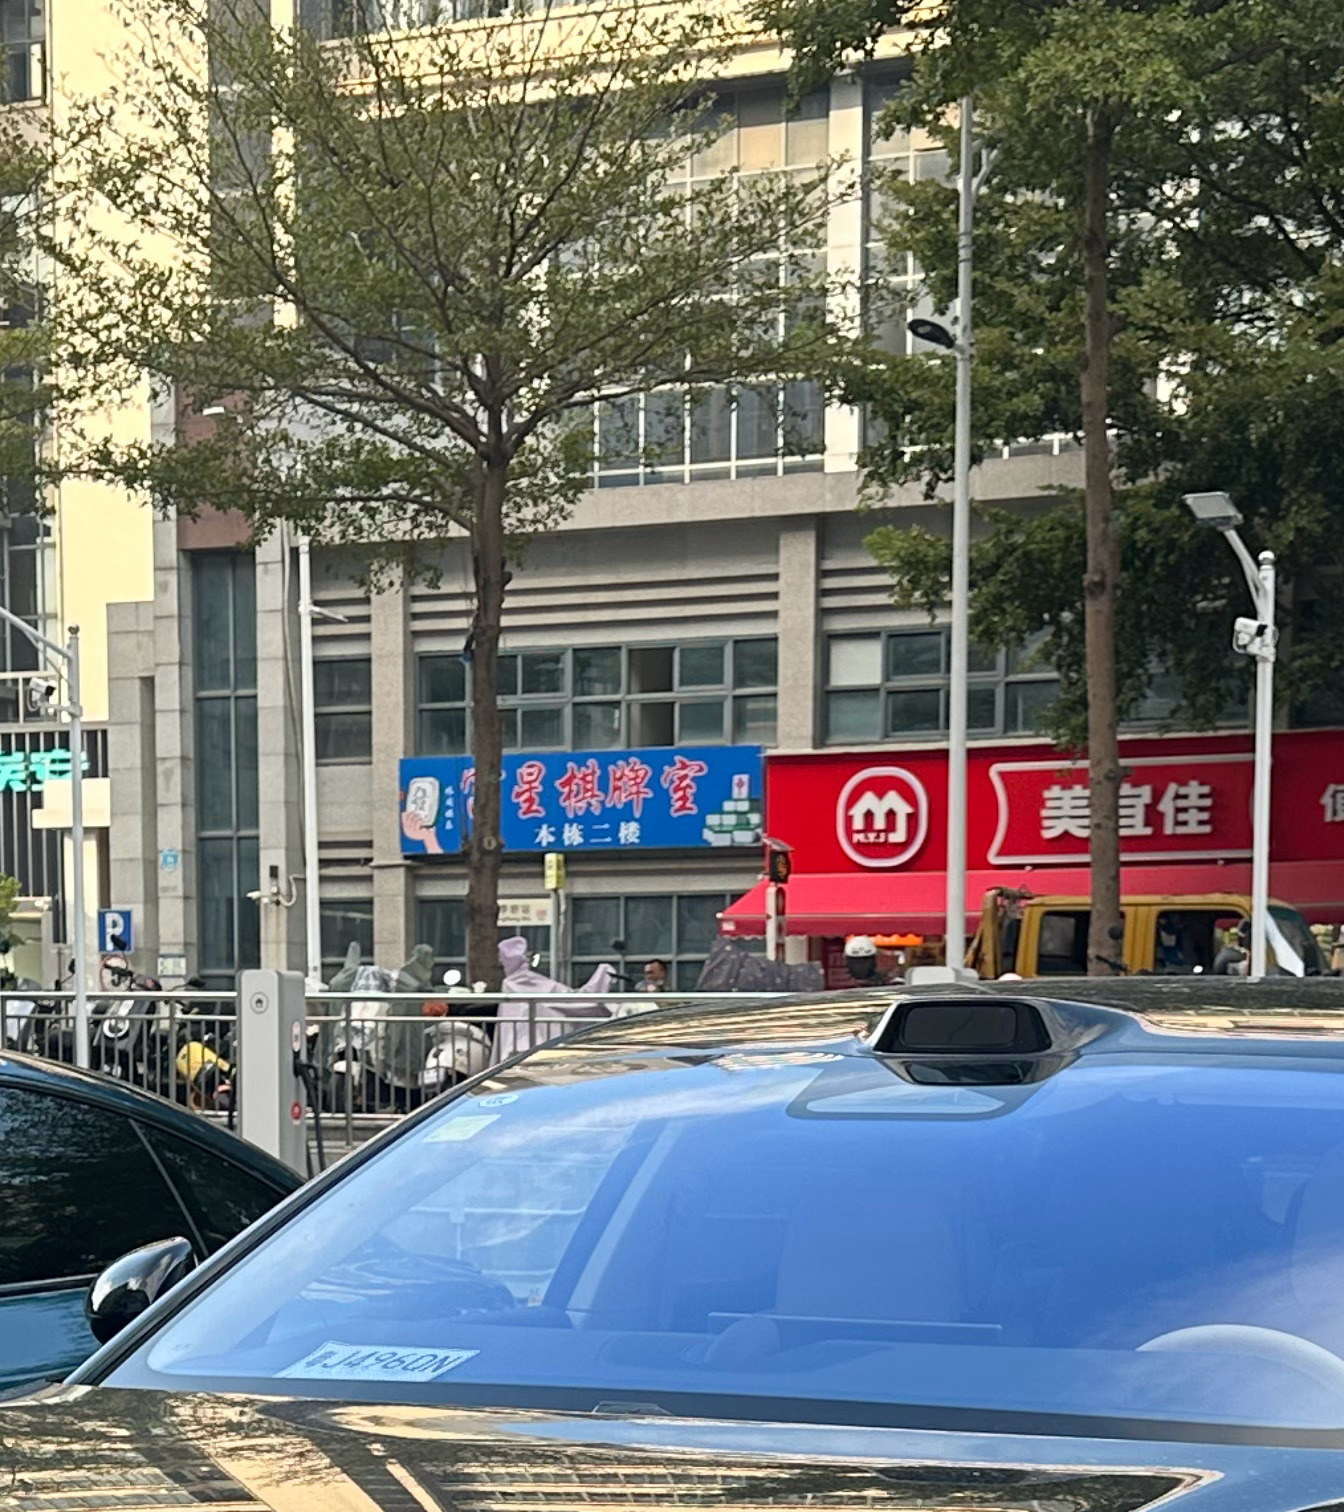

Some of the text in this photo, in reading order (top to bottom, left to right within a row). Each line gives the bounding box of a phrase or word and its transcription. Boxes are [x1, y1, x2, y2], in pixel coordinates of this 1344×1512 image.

[460, 756, 708, 819] 星棋牌室
[1040, 780, 1213, 839] 美宜佳
[534, 821, 641, 848] 本栋二楼
[104, 912, 125, 952] P
